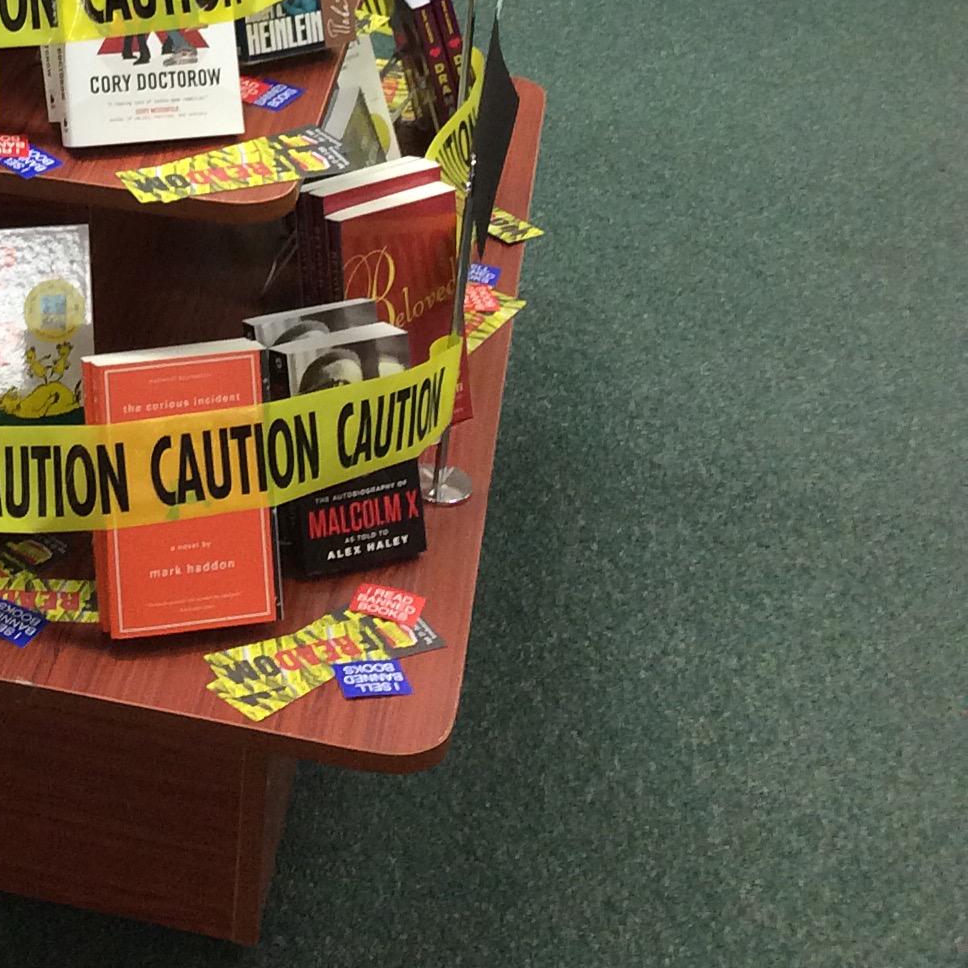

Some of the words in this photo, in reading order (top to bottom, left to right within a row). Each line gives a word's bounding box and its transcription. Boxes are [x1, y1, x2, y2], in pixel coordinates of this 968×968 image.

[246, 10, 325, 57] HEINLEIN
[90, 74, 131, 95] CORY
[136, 68, 221, 92] DOCTOROW
[343, 244, 459, 327] Beloved
[123, 402, 142, 414] the
[145, 400, 189, 412] curious
[193, 393, 241, 407] incident
[150, 411, 320, 507] CAUTION
[337, 367, 446, 470] CAUTION
[314, 496, 329, 505] THE
[332, 482, 395, 502] AUTOBIOGRAPHY
[397, 479, 407, 487] OF
[308, 493, 402, 540] MALCOLM
[405, 488, 419, 520] X
[177, 541, 200, 551] novel
[201, 541, 212, 551] by
[327, 545, 362, 562] ALEX
[366, 534, 409, 552] HALEY
[344, 536, 355, 544] AS
[357, 532, 377, 541] TOLD
[149, 565, 182, 579] mark
[186, 558, 236, 574] haddon
[356, 593, 417, 616] BANNED
[374, 588, 415, 605] READ
[356, 602, 410, 623] BOOKS
[342, 663, 396, 675] BOOKS
[343, 673, 405, 683] BANNED
[354, 682, 390, 693] SELL
